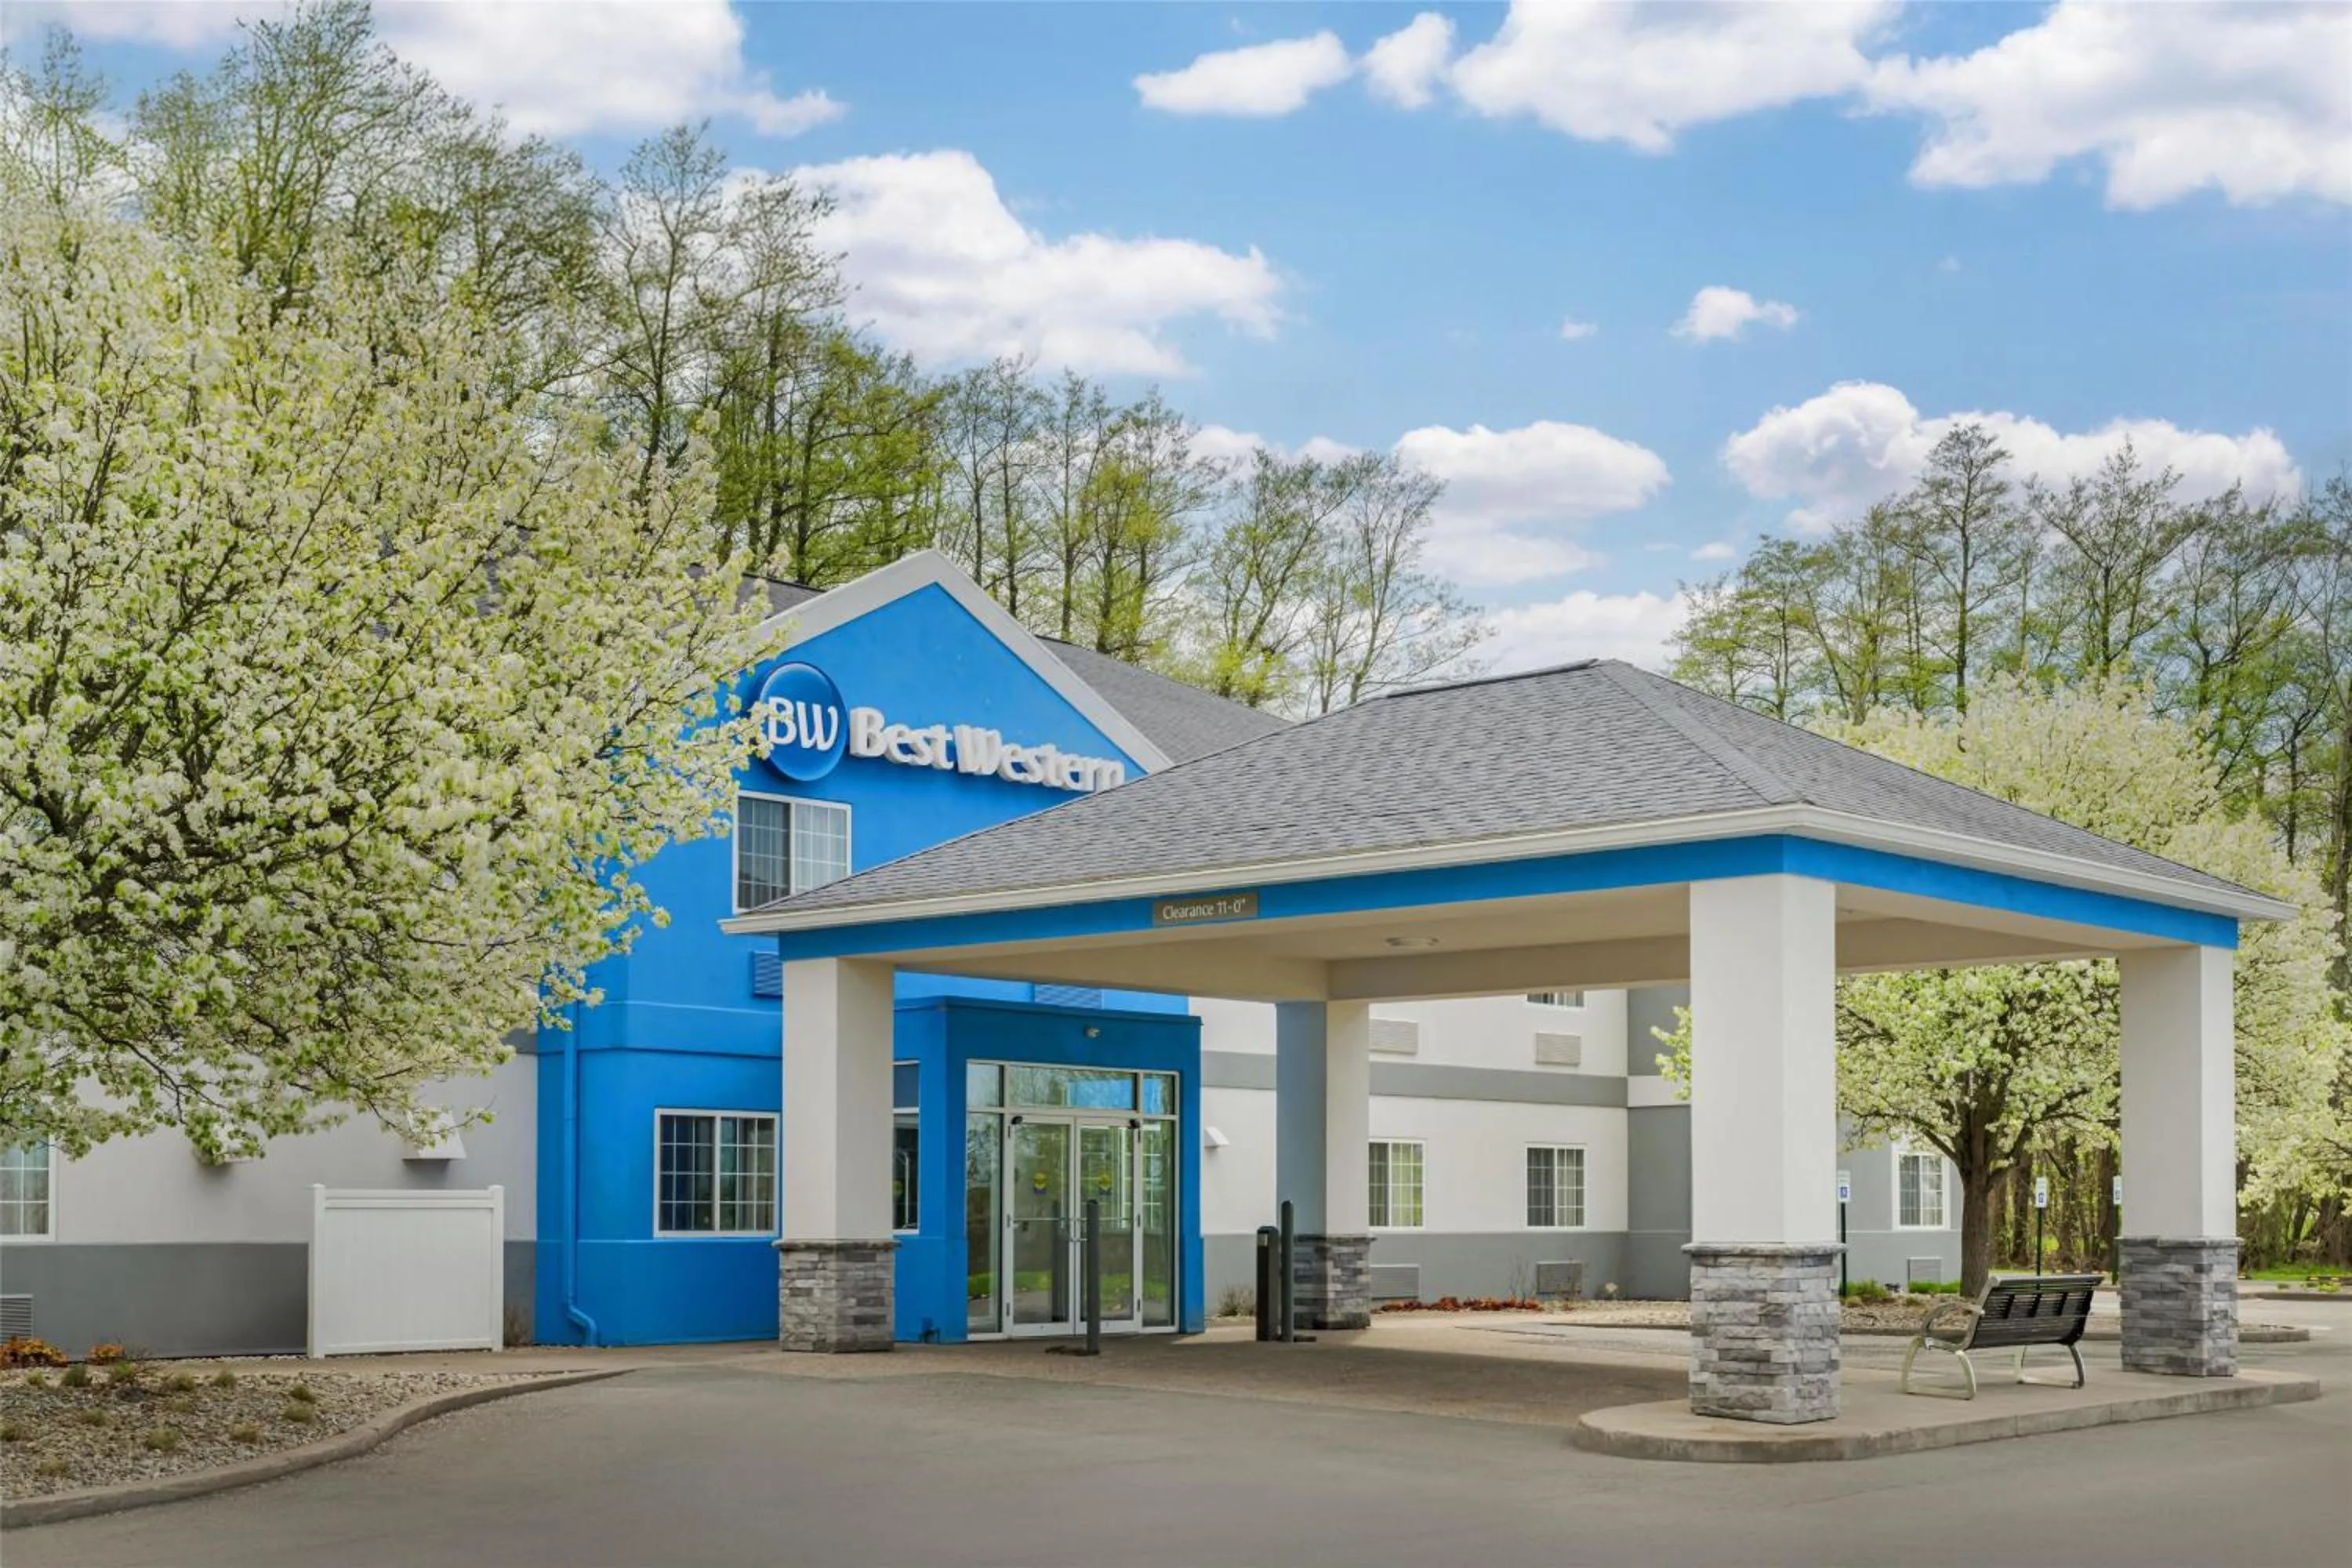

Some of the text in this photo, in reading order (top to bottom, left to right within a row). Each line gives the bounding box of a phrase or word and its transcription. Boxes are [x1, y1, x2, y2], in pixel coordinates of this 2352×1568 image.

[768, 696, 838, 751] BW
[849, 706, 1124, 792] Best Western
[1163, 904, 1214, 920] Clearance
